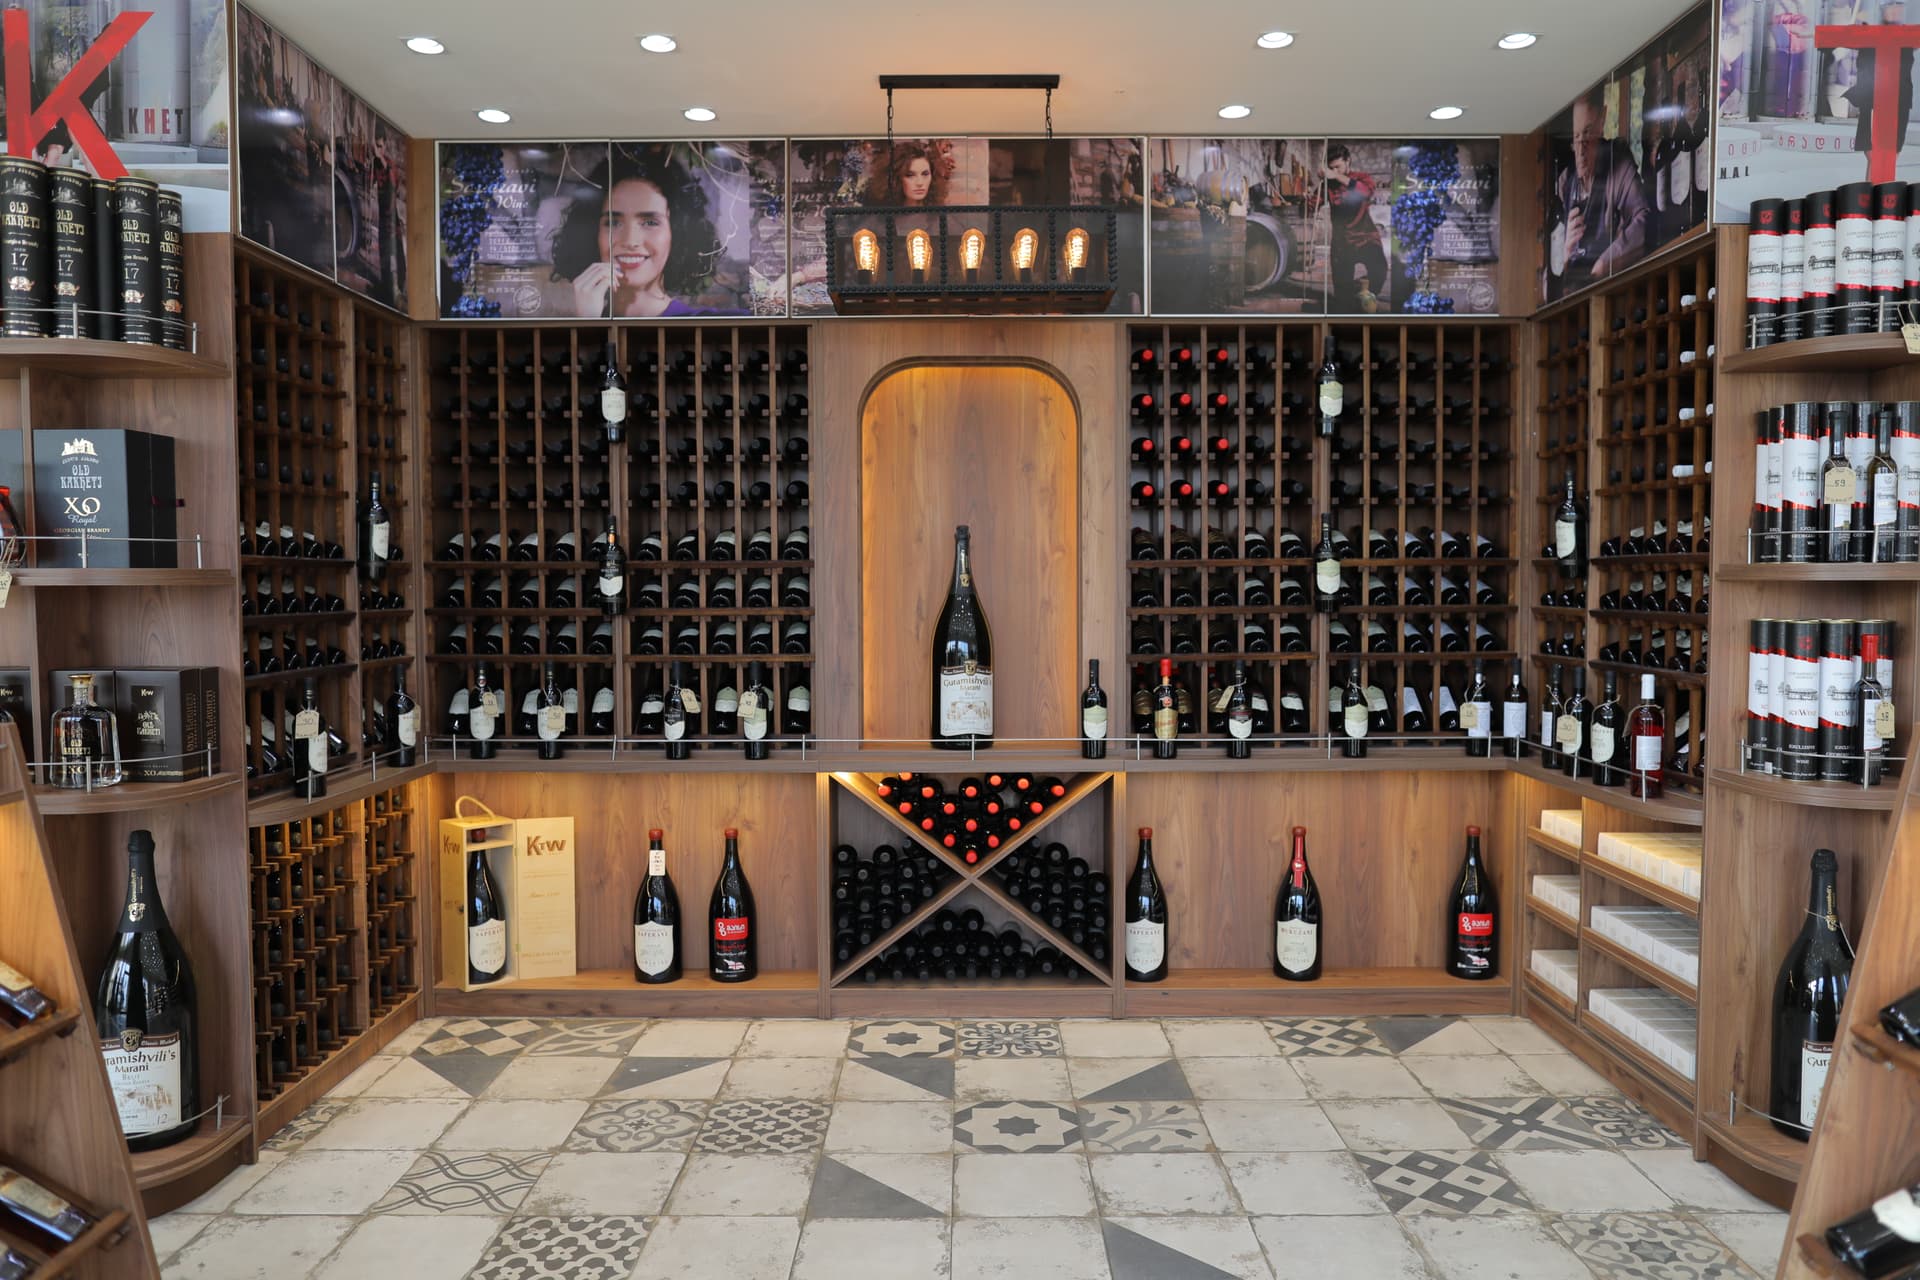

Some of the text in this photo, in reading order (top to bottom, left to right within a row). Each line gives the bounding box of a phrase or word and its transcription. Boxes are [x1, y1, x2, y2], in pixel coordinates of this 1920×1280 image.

[2, 9, 155, 180] K
[1814, 24, 1920, 185] T
[9, 201, 29, 214] OLD
[11, 252, 29, 267] 17
[58, 259, 75, 272] 17
[123, 267, 140, 280] 17
[165, 277, 181, 290] 17
[72, 464, 90, 476] OLD
[64, 496, 101, 517] XO
[105, 1047, 177, 1066] ramishvili's
